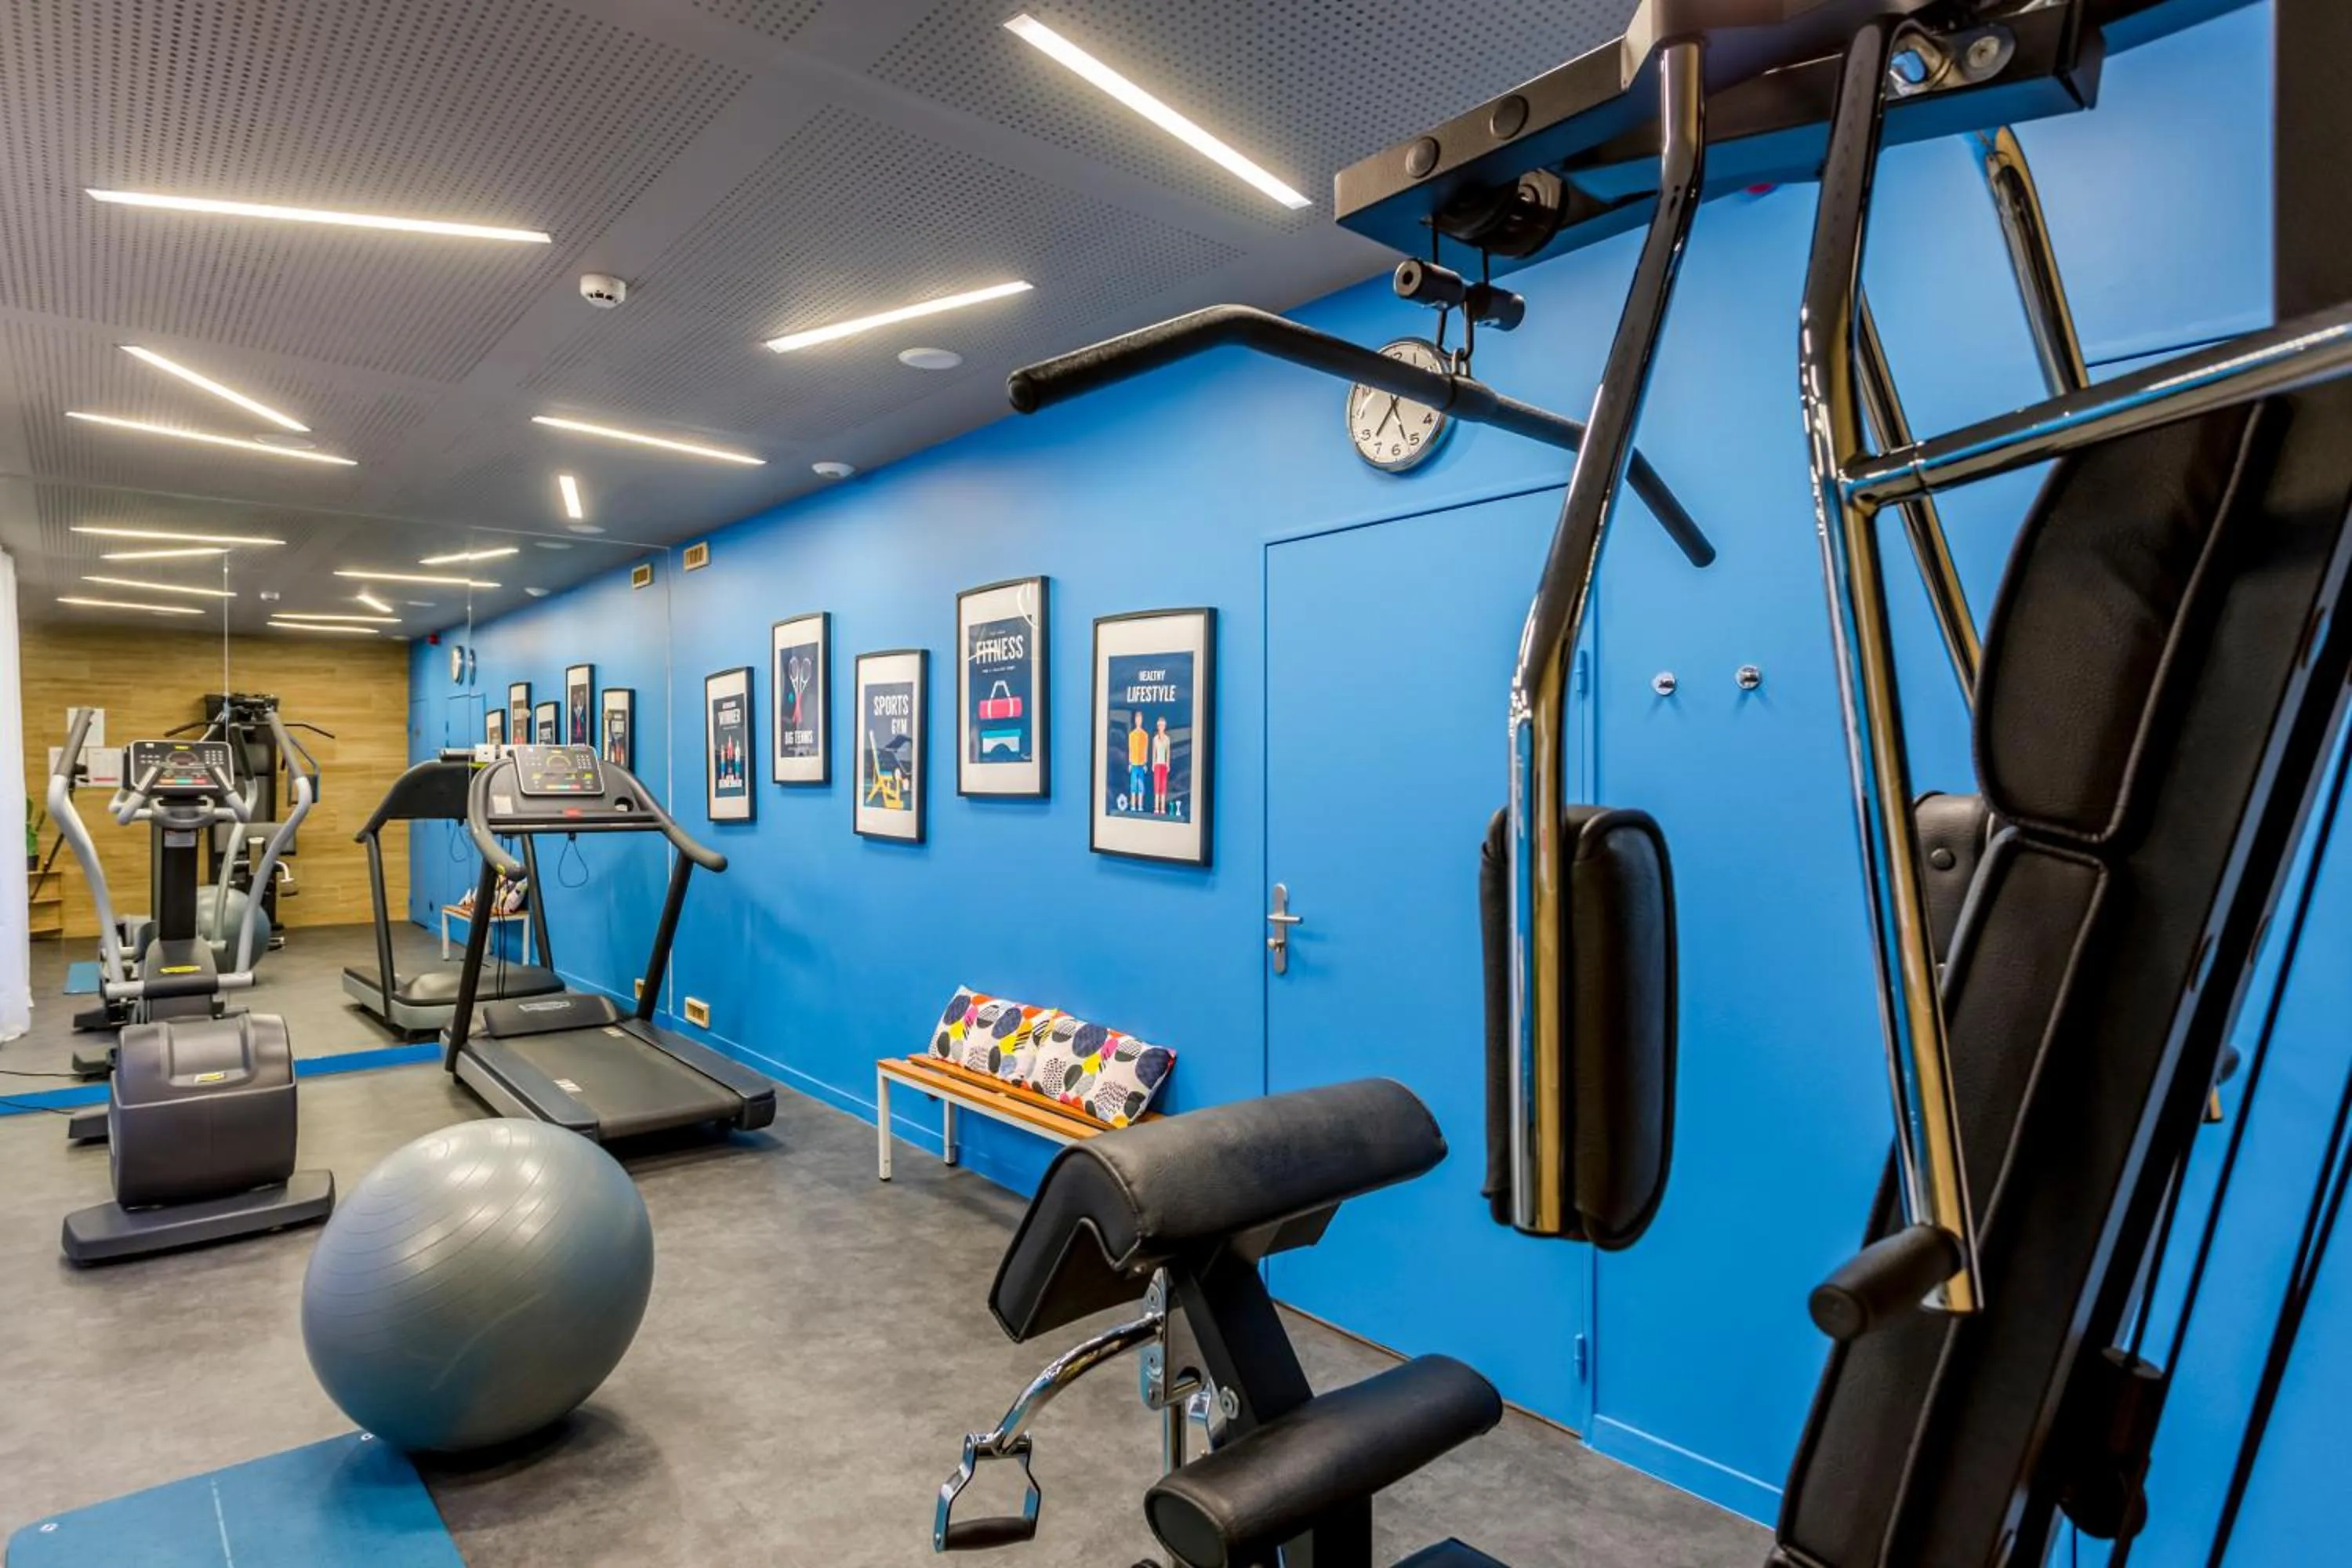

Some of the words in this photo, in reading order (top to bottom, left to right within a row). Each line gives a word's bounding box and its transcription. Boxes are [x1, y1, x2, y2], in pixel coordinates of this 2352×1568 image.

[1423, 412, 1432, 425] 4
[1410, 433, 1420, 446] 5
[1374, 441, 1382, 455] 7
[1392, 445, 1401, 456] 6
[975, 634, 1024, 665] FITNESS
[1138, 669, 1166, 682] HEALTHY
[1127, 684, 1176, 702] LIFESTYLE
[873, 694, 909, 716] SPORTS
[891, 717, 908, 735] GYM
